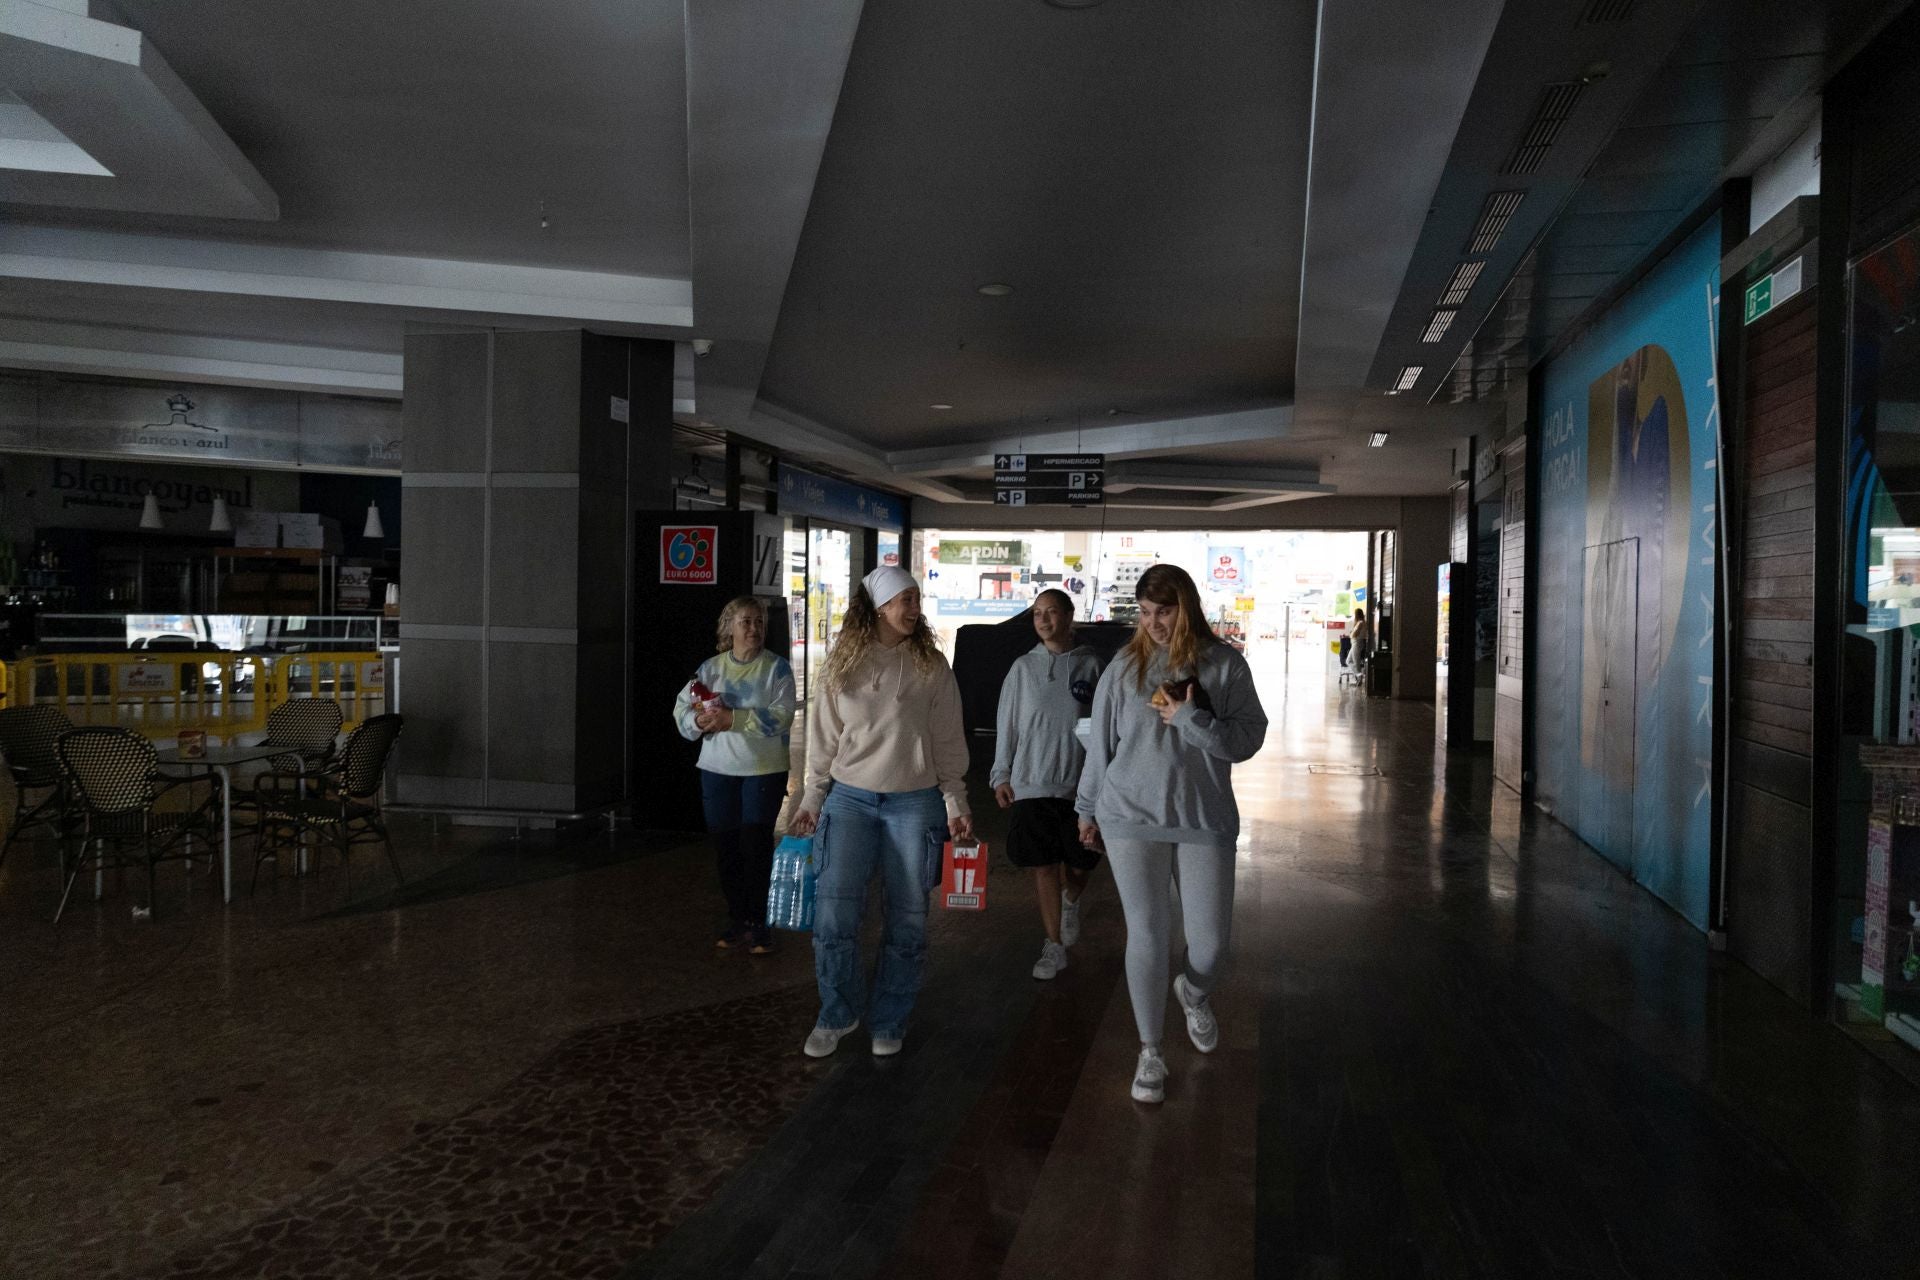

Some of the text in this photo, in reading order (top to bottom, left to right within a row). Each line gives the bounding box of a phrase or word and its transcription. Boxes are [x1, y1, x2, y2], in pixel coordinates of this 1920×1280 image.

[1543, 401, 1575, 450] HOLA
[195, 434, 230, 450] azul
[1043, 457, 1101, 465] HIPERMERCADO
[1071, 474, 1082, 487] P
[802, 479, 826, 504] Viajes
[1013, 492, 1100, 505] P PARKING
[871, 501, 890, 522] Viajes
[666, 570, 712, 579] EURO 6000
